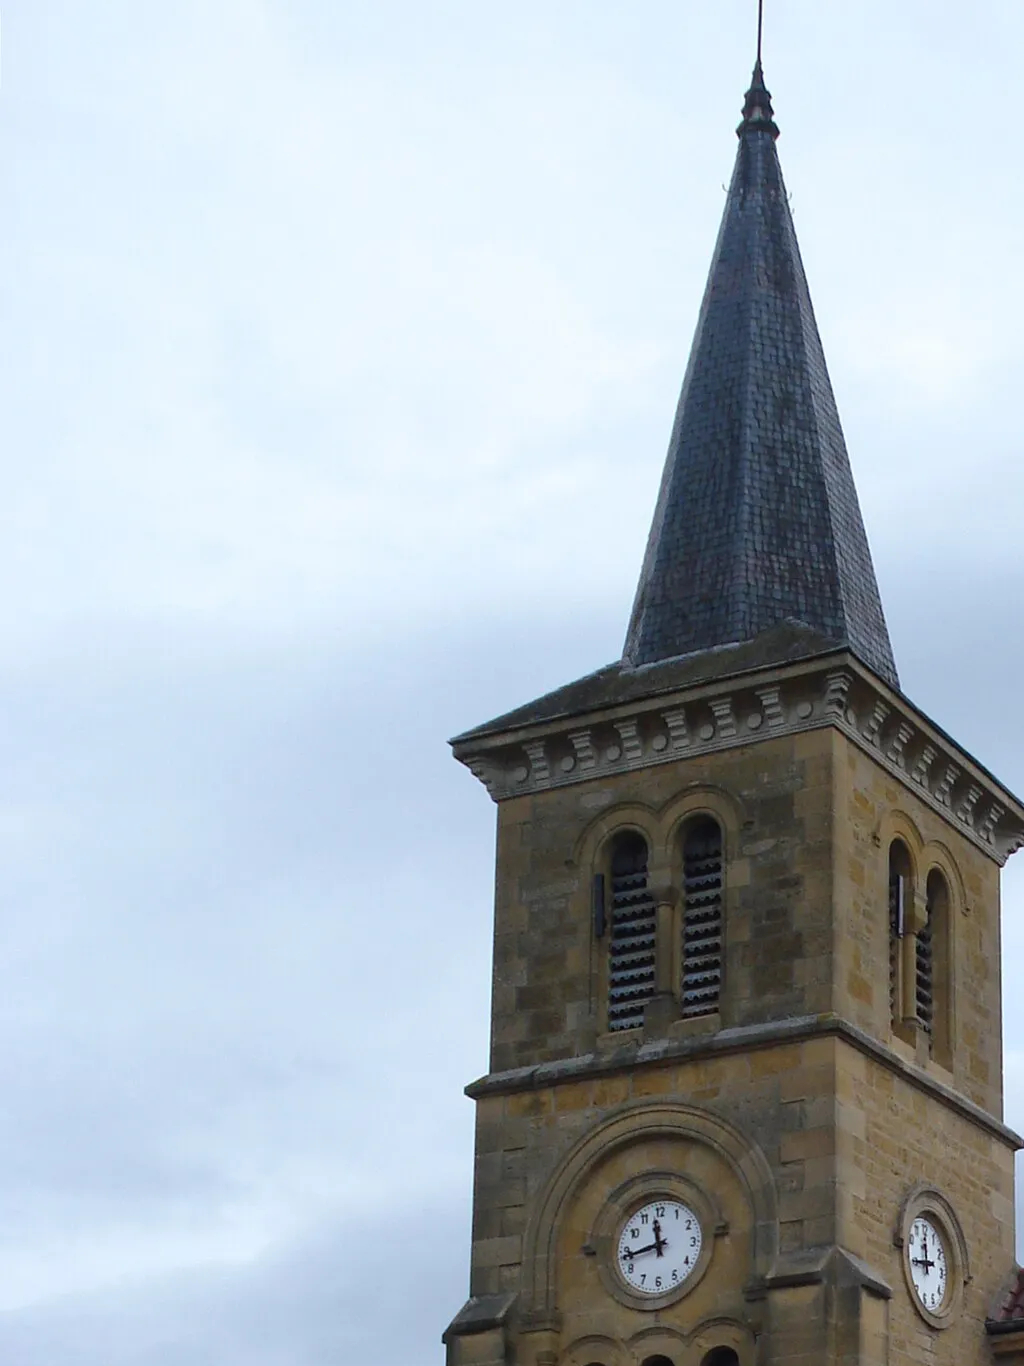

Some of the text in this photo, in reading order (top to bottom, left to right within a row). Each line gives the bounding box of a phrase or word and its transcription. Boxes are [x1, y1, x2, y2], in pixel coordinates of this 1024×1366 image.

[656, 1206, 665, 1217] 12
[675, 1209, 679, 1220] 1
[641, 1214, 648, 1224] 11
[685, 1219, 692, 1231] 2
[630, 1228, 639, 1239] 10
[690, 1237, 697, 1247] 3
[684, 1256, 689, 1265] 4
[628, 1263, 634, 1274] 8
[640, 1274, 646, 1285] 7
[672, 1269, 678, 1281] 5
[655, 1277, 661, 1287] 6
